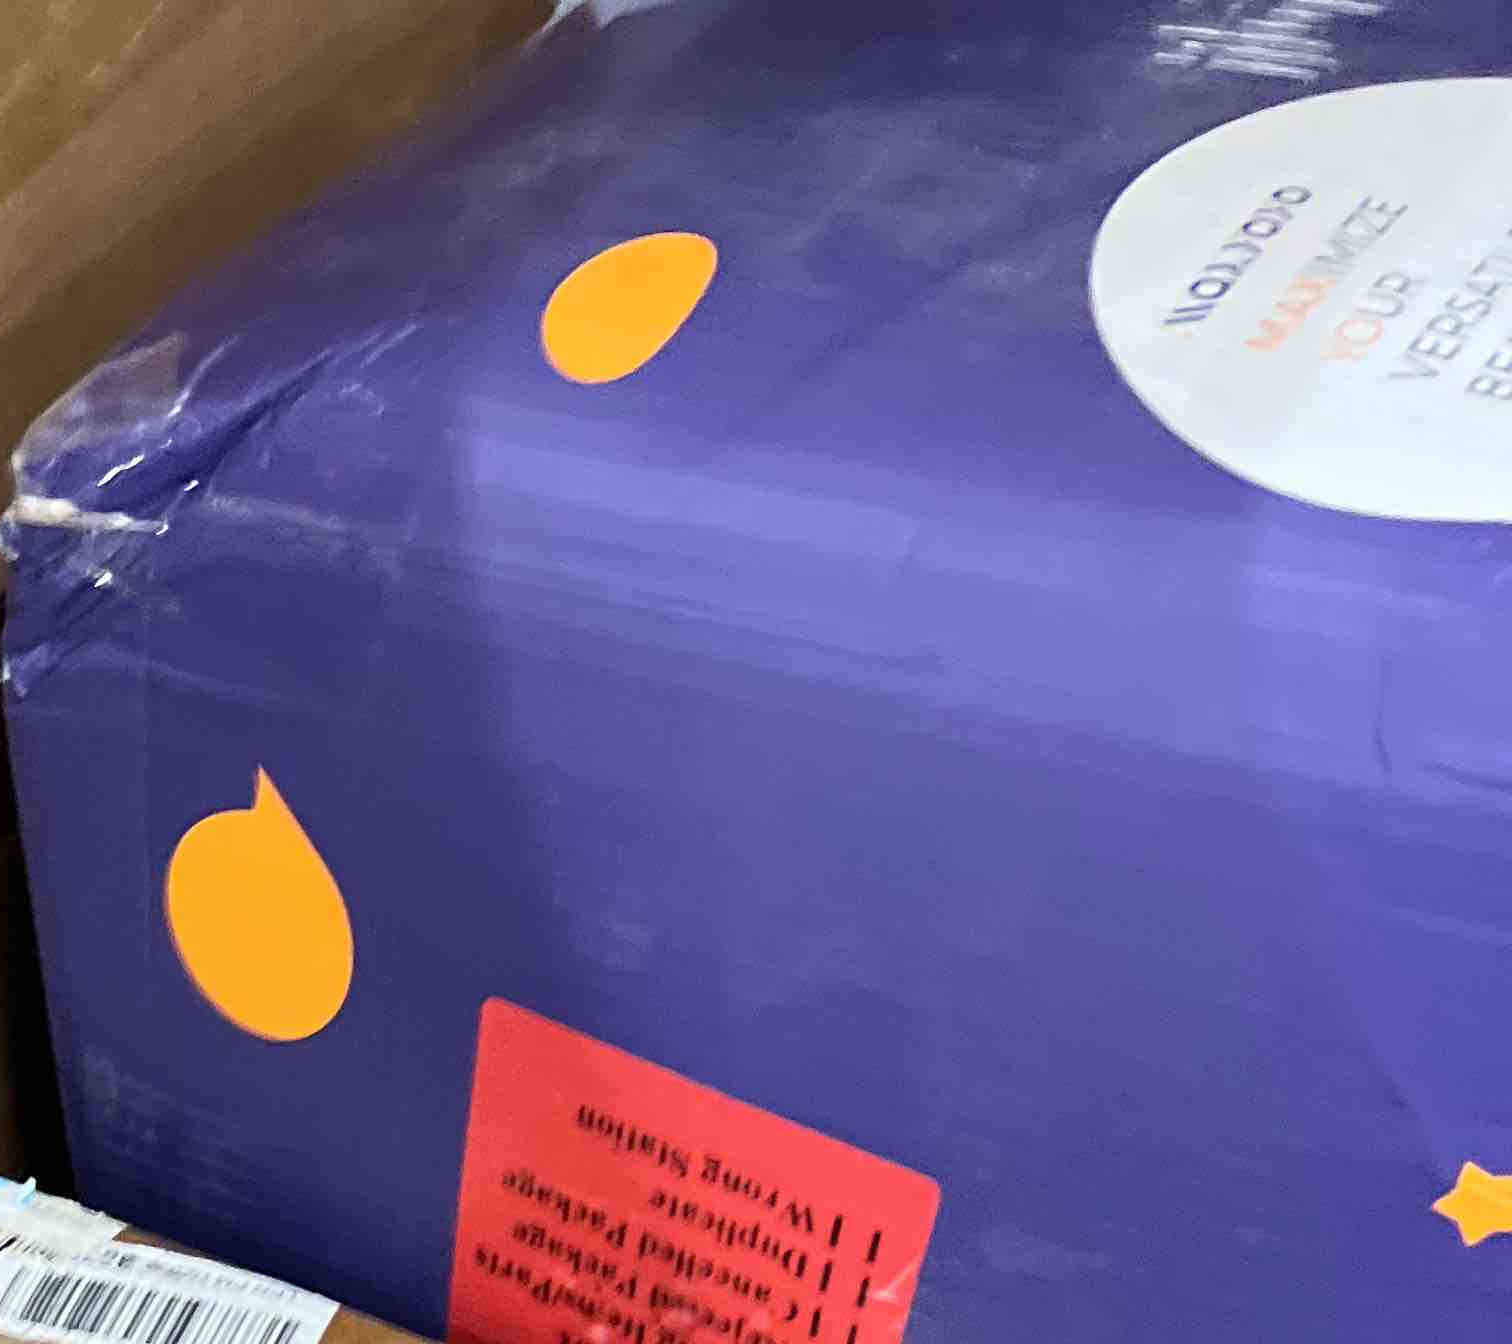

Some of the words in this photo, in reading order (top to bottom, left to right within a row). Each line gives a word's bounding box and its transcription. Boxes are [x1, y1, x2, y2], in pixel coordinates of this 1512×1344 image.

[576, 1103, 690, 1177] Station
[501, 1167, 629, 1249] Package
[648, 1189, 808, 1279] Duplicate
[700, 1156, 815, 1233] Wrong
[512, 1220, 639, 1300] Package
[638, 1231, 800, 1322] Cancelled
